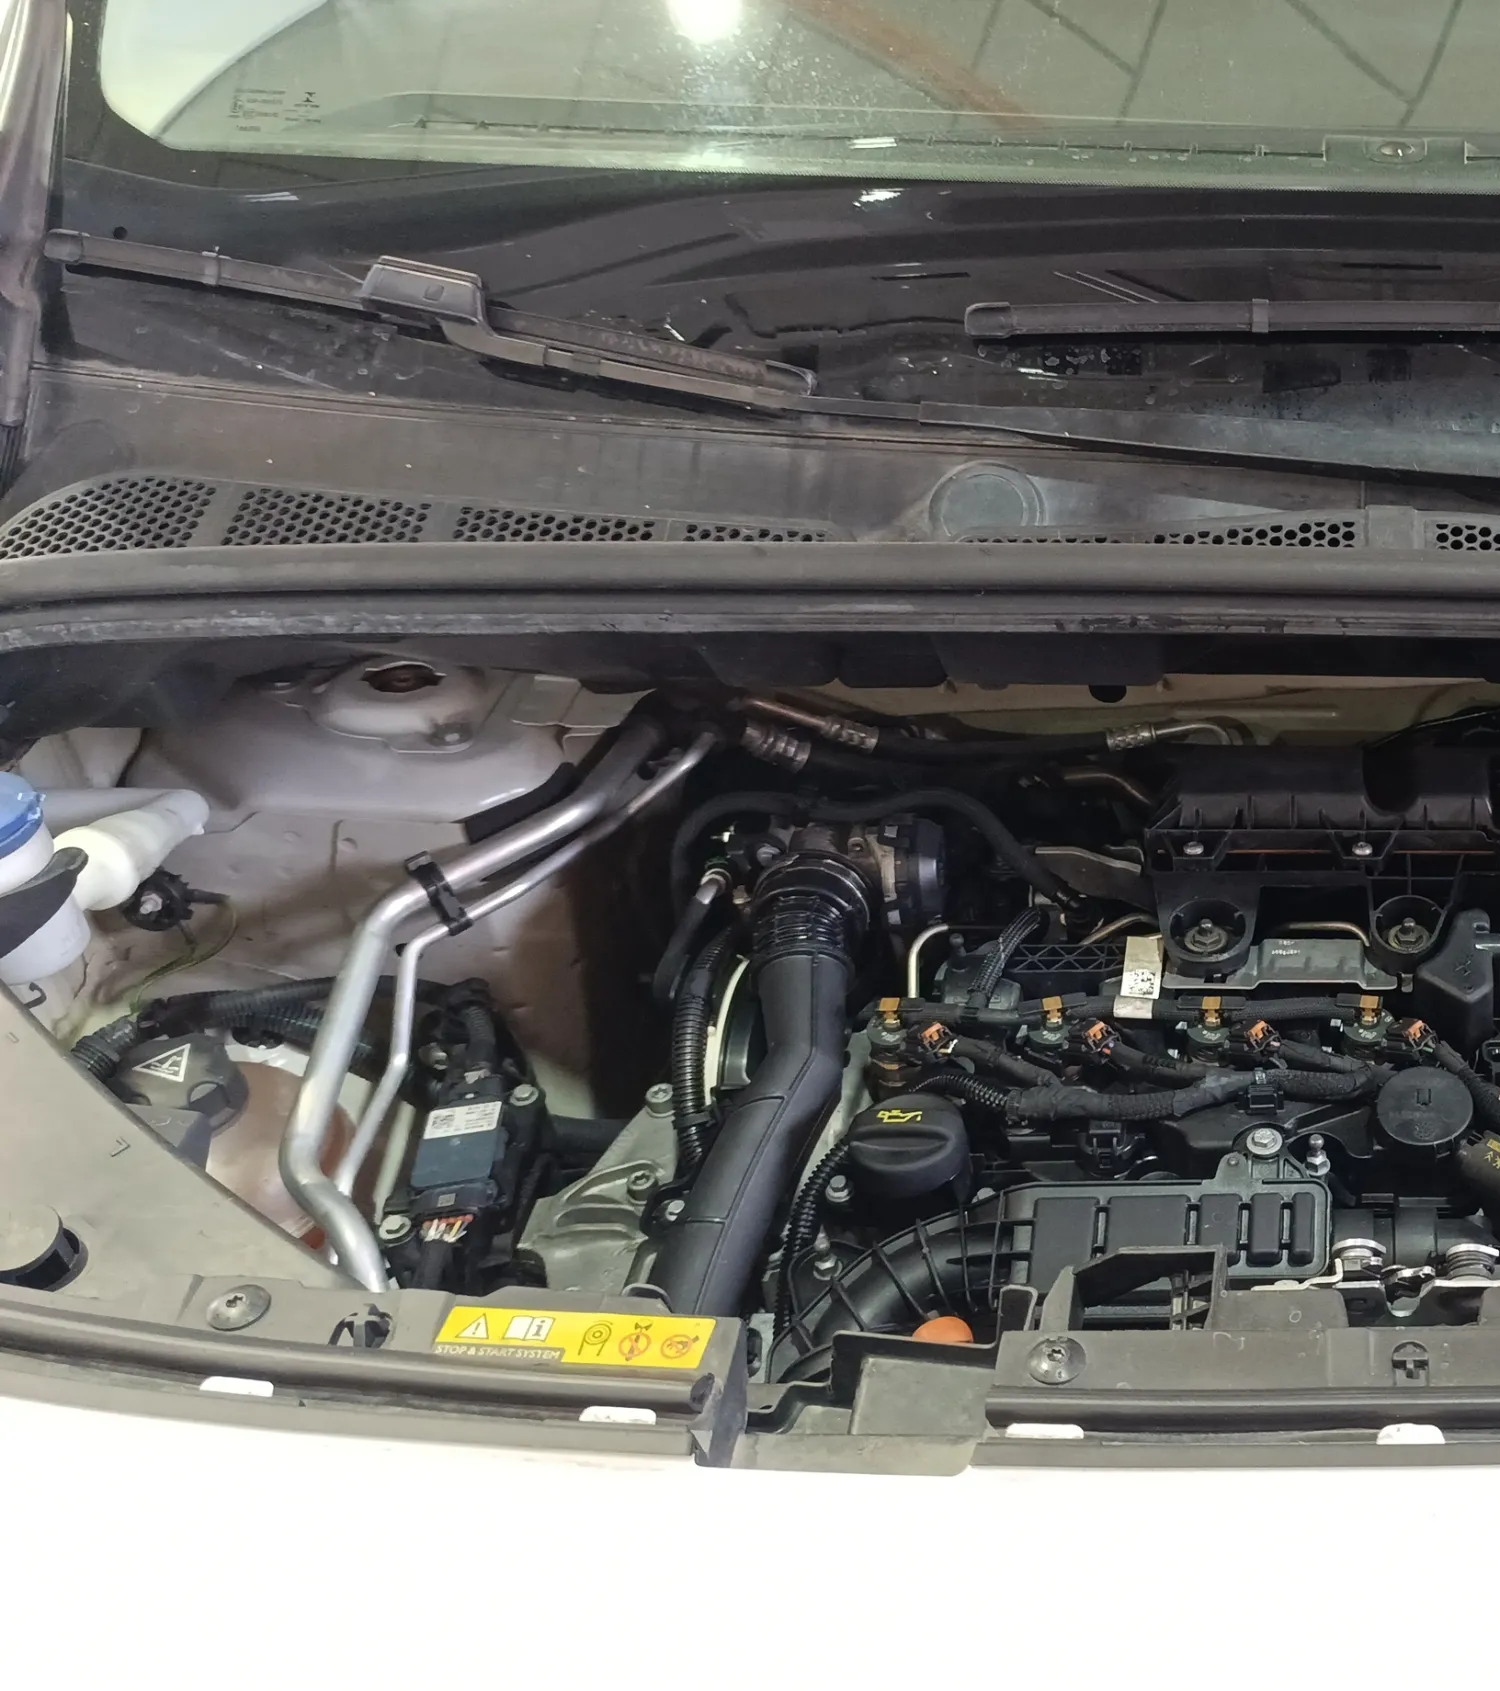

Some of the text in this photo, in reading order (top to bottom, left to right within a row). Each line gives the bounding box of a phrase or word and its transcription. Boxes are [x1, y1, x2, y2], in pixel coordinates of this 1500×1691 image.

[435, 1344, 561, 1360] STOP & START SYSTEM
